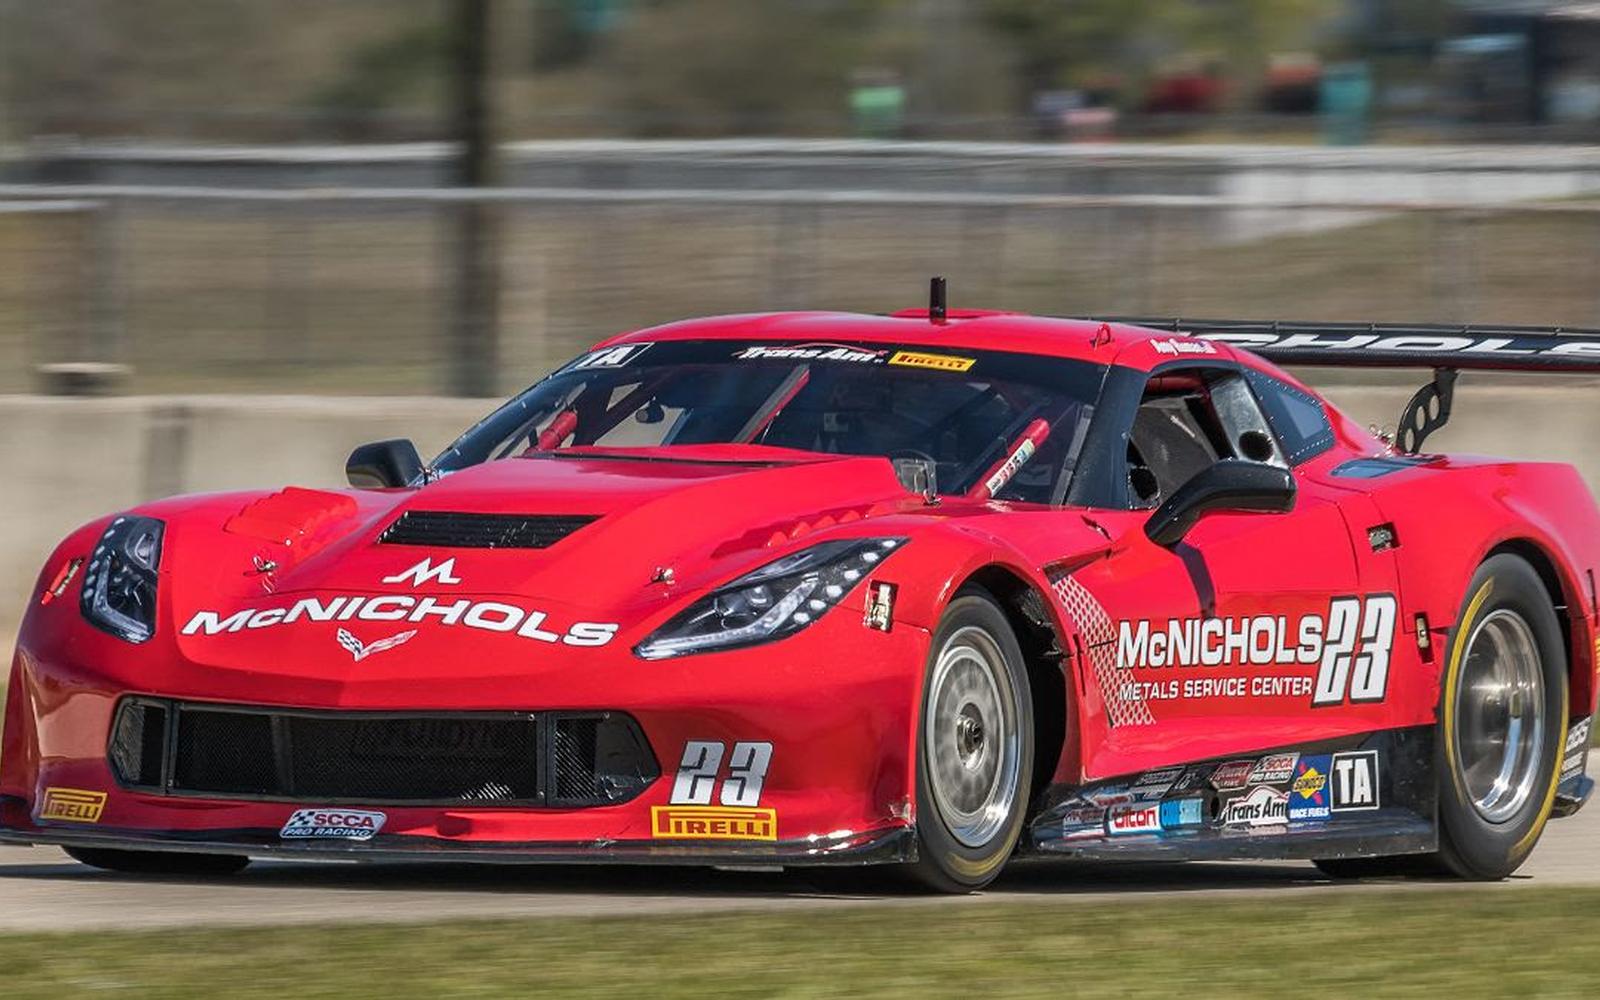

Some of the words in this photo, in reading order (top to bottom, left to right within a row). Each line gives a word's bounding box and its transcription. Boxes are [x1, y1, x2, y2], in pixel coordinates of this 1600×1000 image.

[737, 347, 821, 359] Trans
[817, 348, 876, 362] Am
[181, 595, 619, 647] McNICHOLS
[1116, 615, 1324, 669] McNICHOLS
[1311, 593, 1396, 708] 23
[1119, 681, 1179, 700] METALS
[1183, 678, 1247, 698] SERVICE
[1251, 676, 1313, 696] CENTER
[669, 741, 774, 807] 23
[1335, 758, 1373, 805] TA
[42, 791, 102, 819] PIRELLI
[1227, 802, 1260, 820] Trans
[1262, 796, 1284, 818] Am
[284, 826, 313, 836] PRO
[314, 827, 371, 836] RACING
[314, 813, 375, 828] SCCA
[657, 810, 771, 837] PIRELLI
